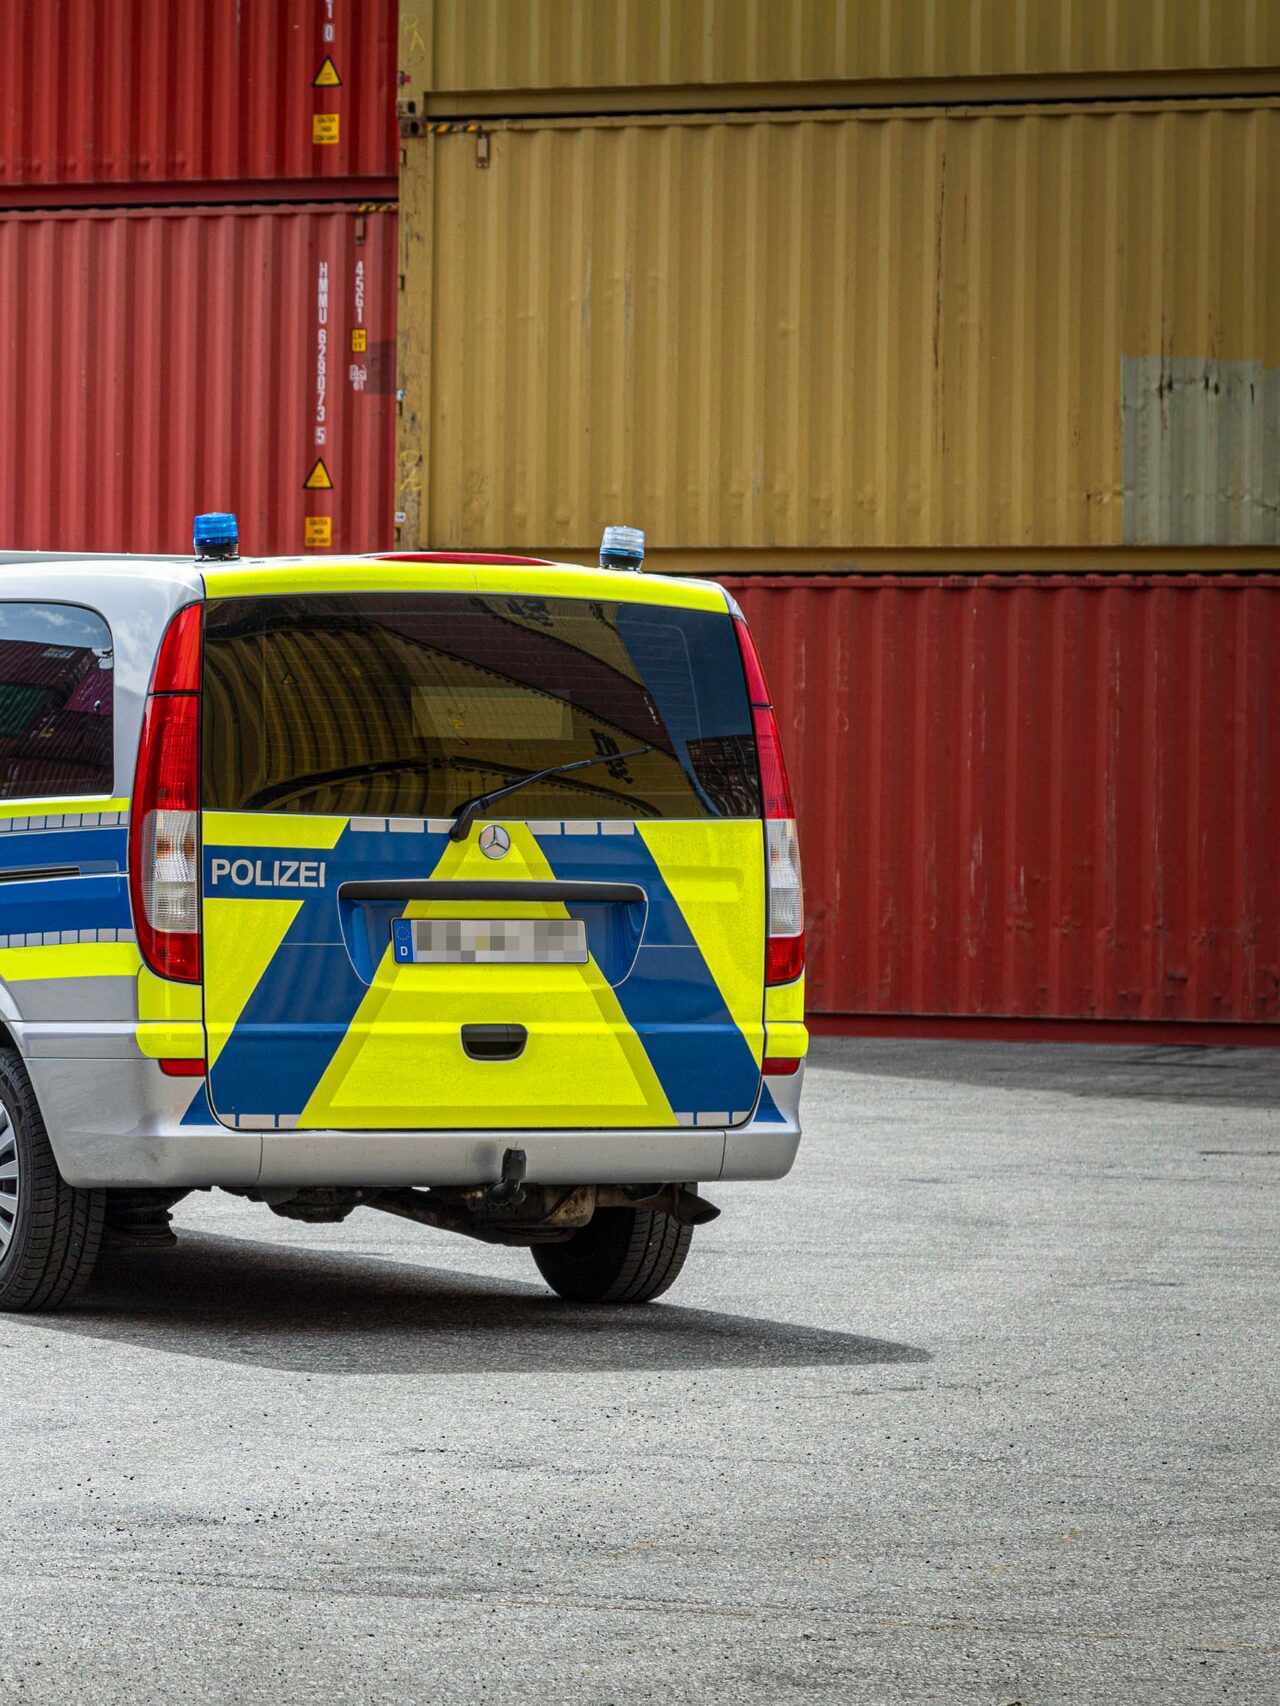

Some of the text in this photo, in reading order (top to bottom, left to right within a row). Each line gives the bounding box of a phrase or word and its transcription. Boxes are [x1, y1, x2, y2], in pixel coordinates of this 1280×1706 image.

[314, 261, 329, 445] HMMU 629073 5
[211, 858, 325, 888] POLIZEI
[400, 946, 408, 956] D
